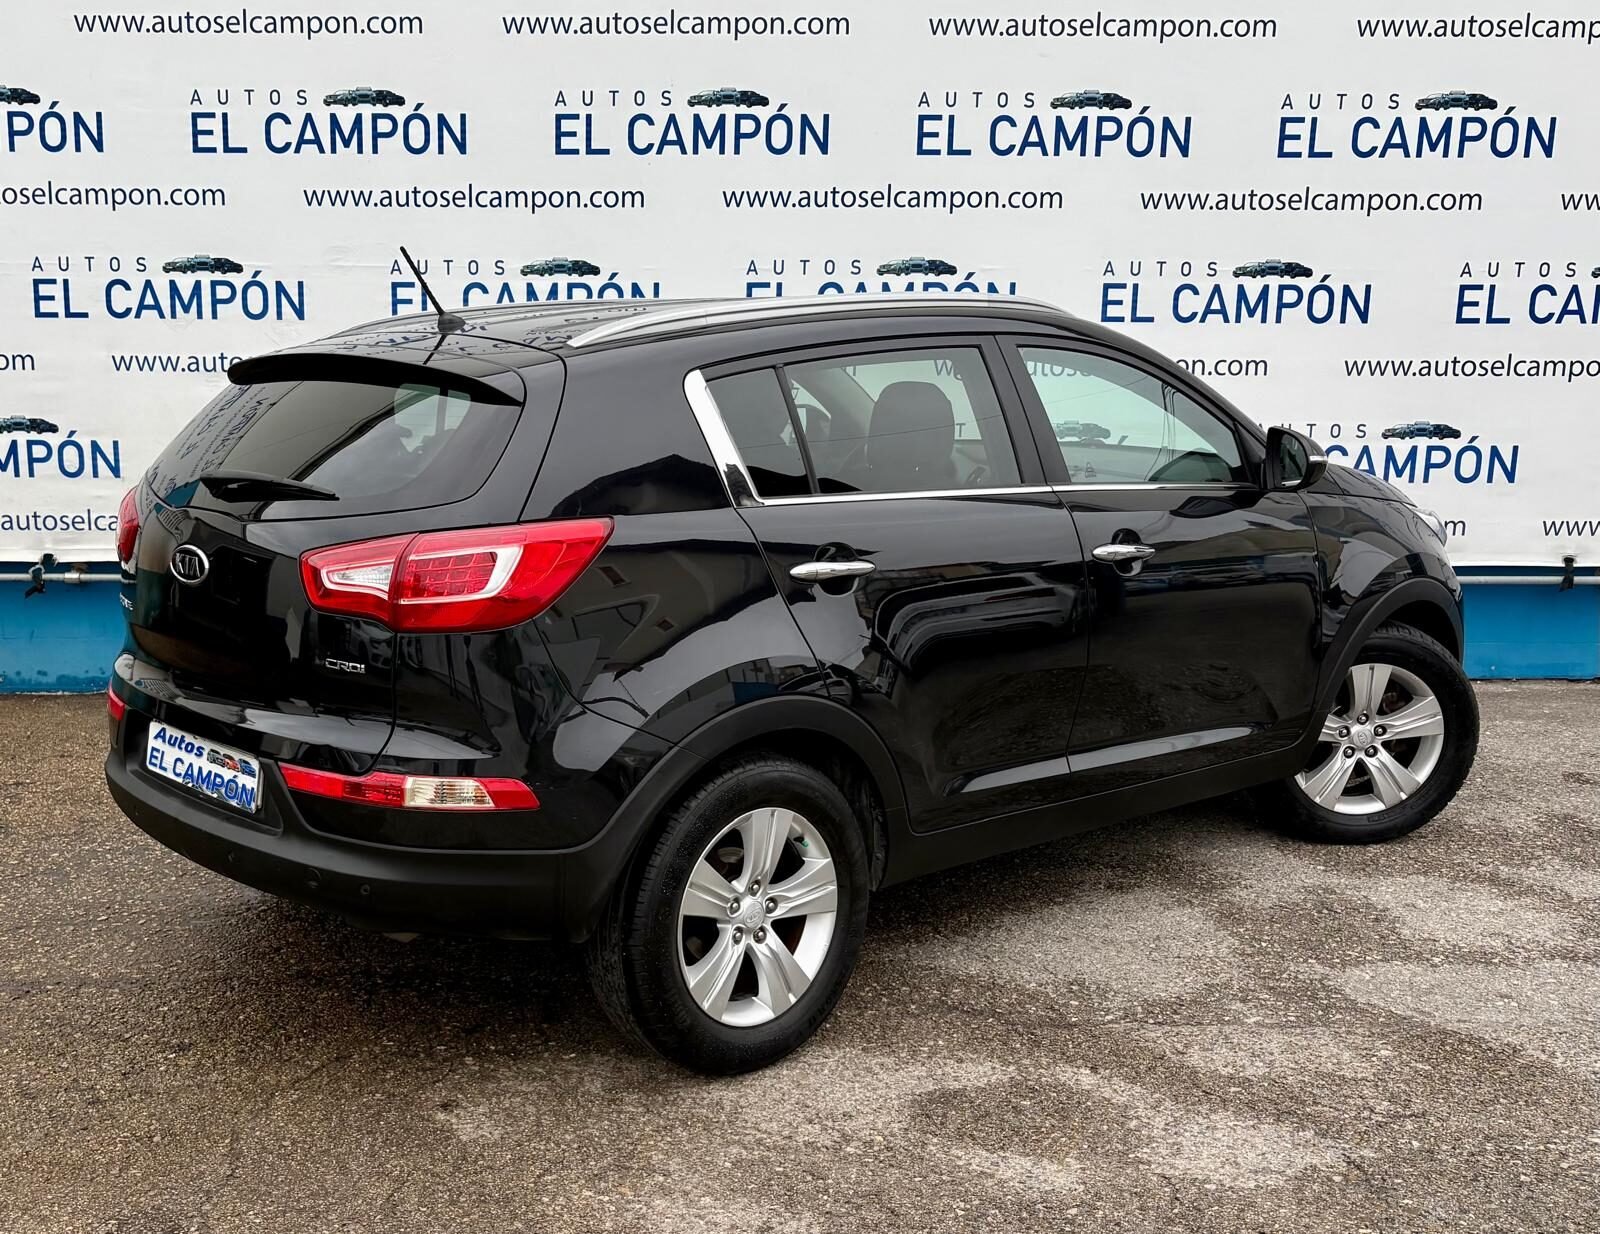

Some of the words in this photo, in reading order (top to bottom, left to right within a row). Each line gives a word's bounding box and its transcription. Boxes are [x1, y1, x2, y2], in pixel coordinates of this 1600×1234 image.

[74, 9, 423, 41] www.autoselcampon.com
[503, 9, 850, 41] www.autoselcampon.com
[929, 12, 1277, 44] www.autoselcampon.com
[1357, 13, 1600, 45] www.autoselcamp
[190, 89, 308, 106] AUTOS
[554, 90, 672, 107] AUTOS
[917, 92, 1035, 108] AUTOS
[1281, 93, 1400, 110] AUTOS
[6, 101, 105, 153] PÓN
[191, 112, 248, 154] EL
[264, 102, 467, 155] CAMPÓN
[555, 114, 611, 156] EL
[627, 104, 830, 156] CAMPÓN
[916, 115, 972, 156] EL
[989, 105, 1192, 158] CAMPÓN
[1277, 117, 1333, 159] EL
[1351, 106, 1557, 159] CAMPÓN
[304, 184, 645, 215] www.autoselcampon.com
[722, 184, 1063, 215] www.autoselcampon.com
[1141, 187, 1483, 217] www.autoselcampon.com
[32, 256, 147, 272] AUTOS
[390, 259, 505, 276] AUTOS
[746, 259, 862, 276] AUTOS
[1103, 261, 1218, 278] AUTOS
[1460, 262, 1577, 278] AUTOS
[33, 278, 89, 319] EL
[104, 270, 305, 321] CAMPÓN
[1100, 283, 1154, 323] EL
[1172, 274, 1372, 325] CAMPÓN
[1455, 284, 1511, 325] EL
[1528, 284, 1600, 325] CA
[1345, 353, 1600, 383] www.autoselcampo
[153, 726, 206, 758] Autos
[147, 746, 169, 773] EL
[172, 757, 255, 807] CAMPÓN
